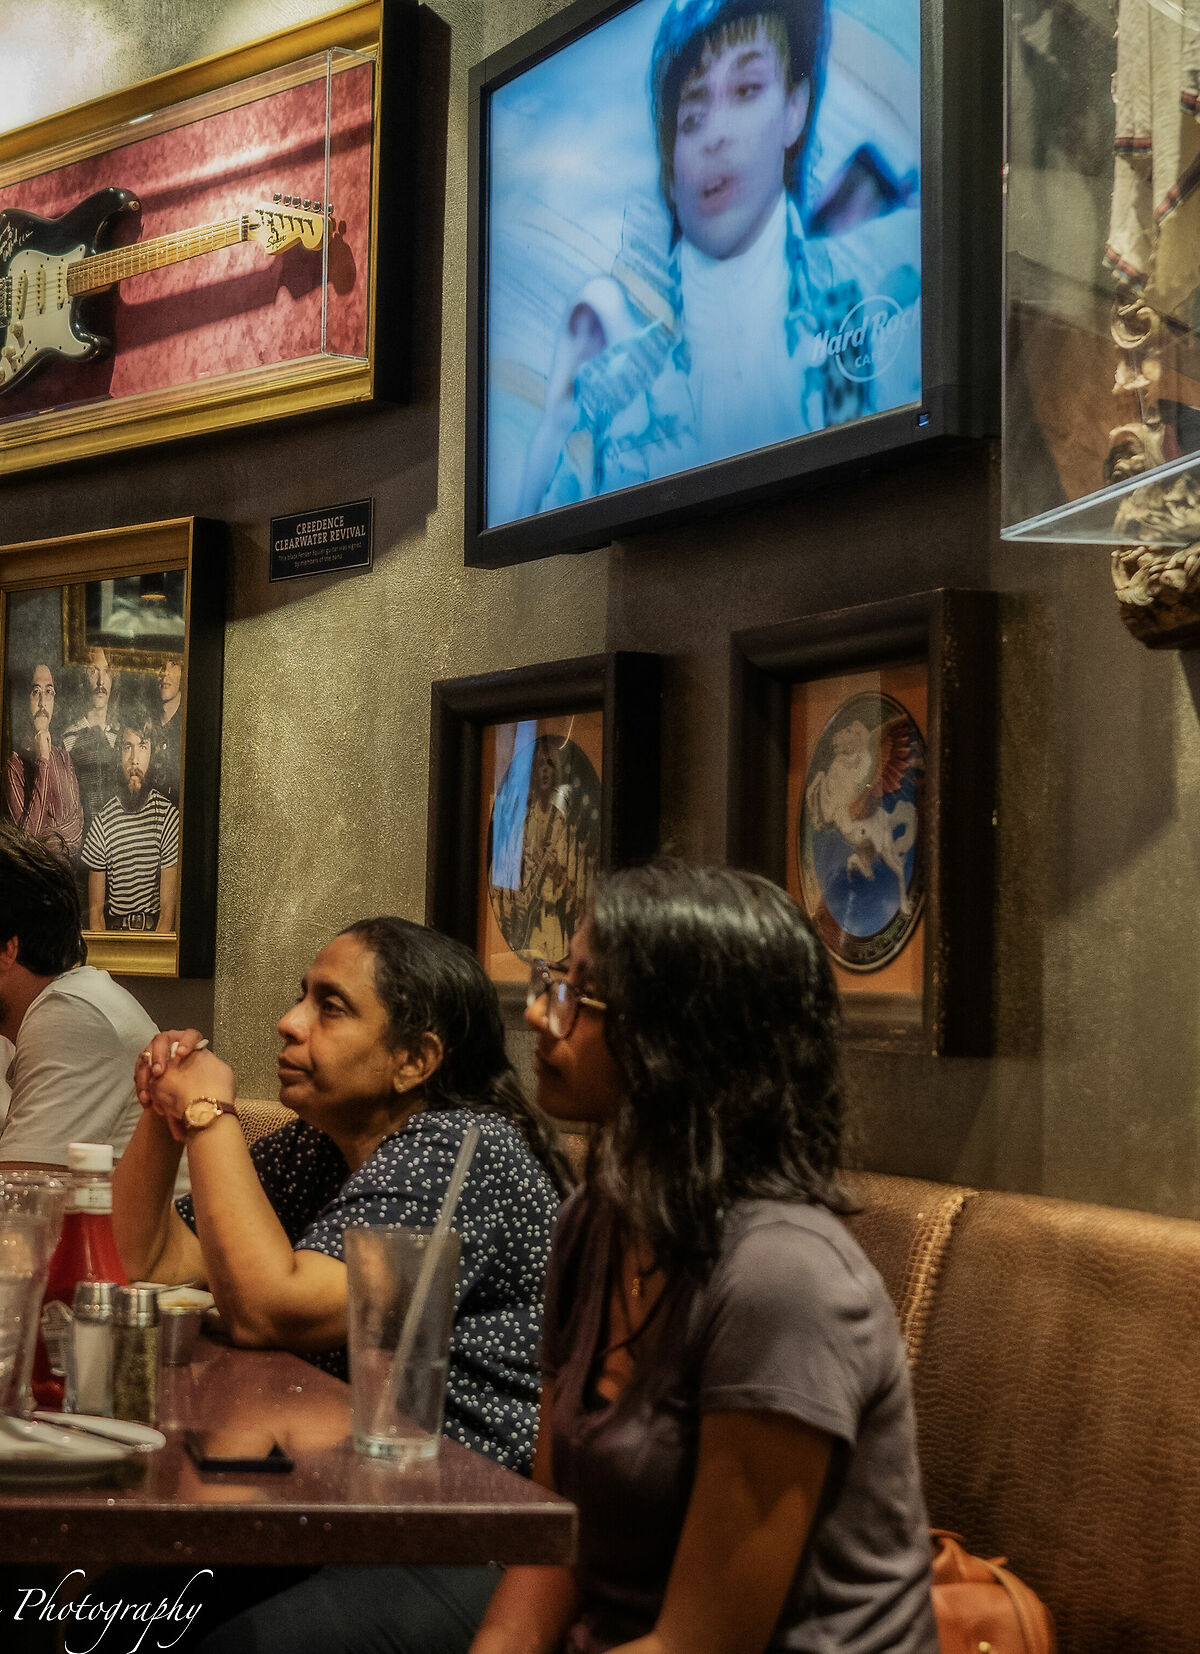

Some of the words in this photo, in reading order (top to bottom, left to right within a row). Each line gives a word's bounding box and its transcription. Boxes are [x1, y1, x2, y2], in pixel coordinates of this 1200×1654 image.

[810, 316, 869, 364] Hard
[274, 531, 328, 552] CLEARWATER
[330, 525, 366, 542] REVIVAL
[296, 515, 345, 535] CREEDENCE
